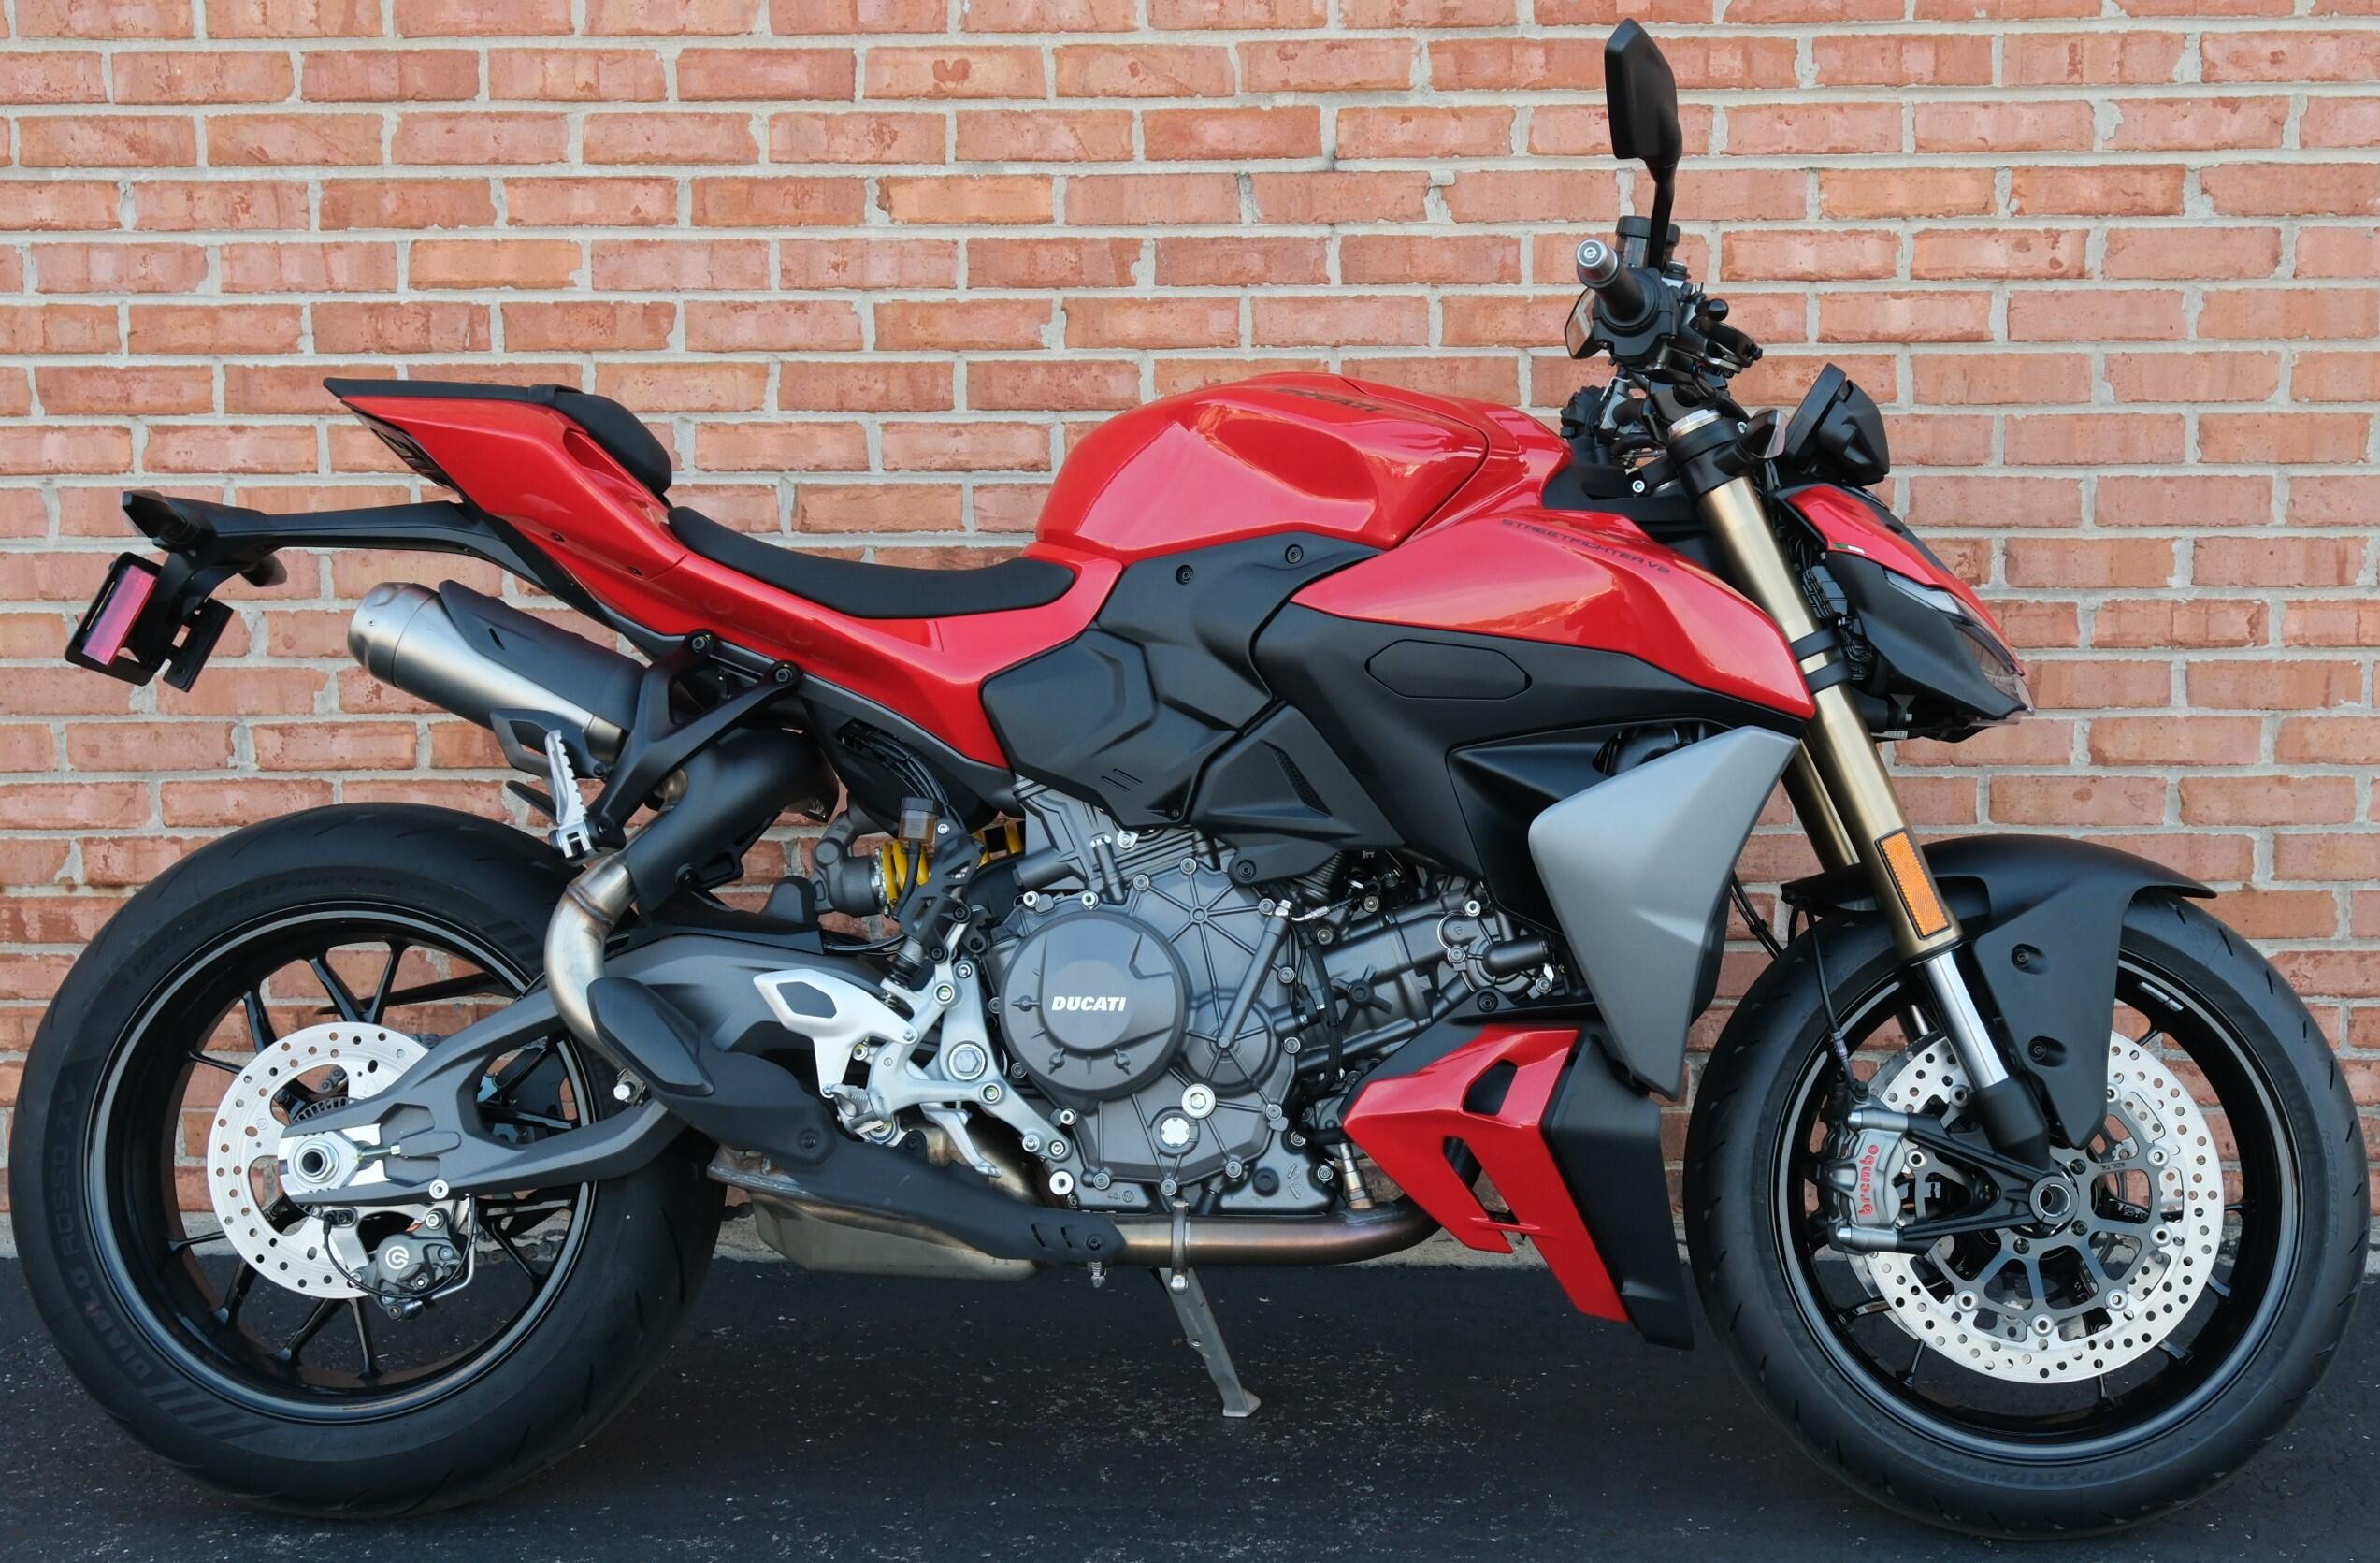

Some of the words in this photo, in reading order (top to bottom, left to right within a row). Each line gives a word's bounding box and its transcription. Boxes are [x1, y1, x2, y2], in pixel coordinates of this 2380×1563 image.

[1500, 518, 1645, 564] STREETFIGHTER
[1648, 561, 1671, 574] V2
[1051, 995, 1127, 1011] DUCATI
[52, 1145, 80, 1257] ROSSO
[1858, 1144, 1880, 1215] brembo
